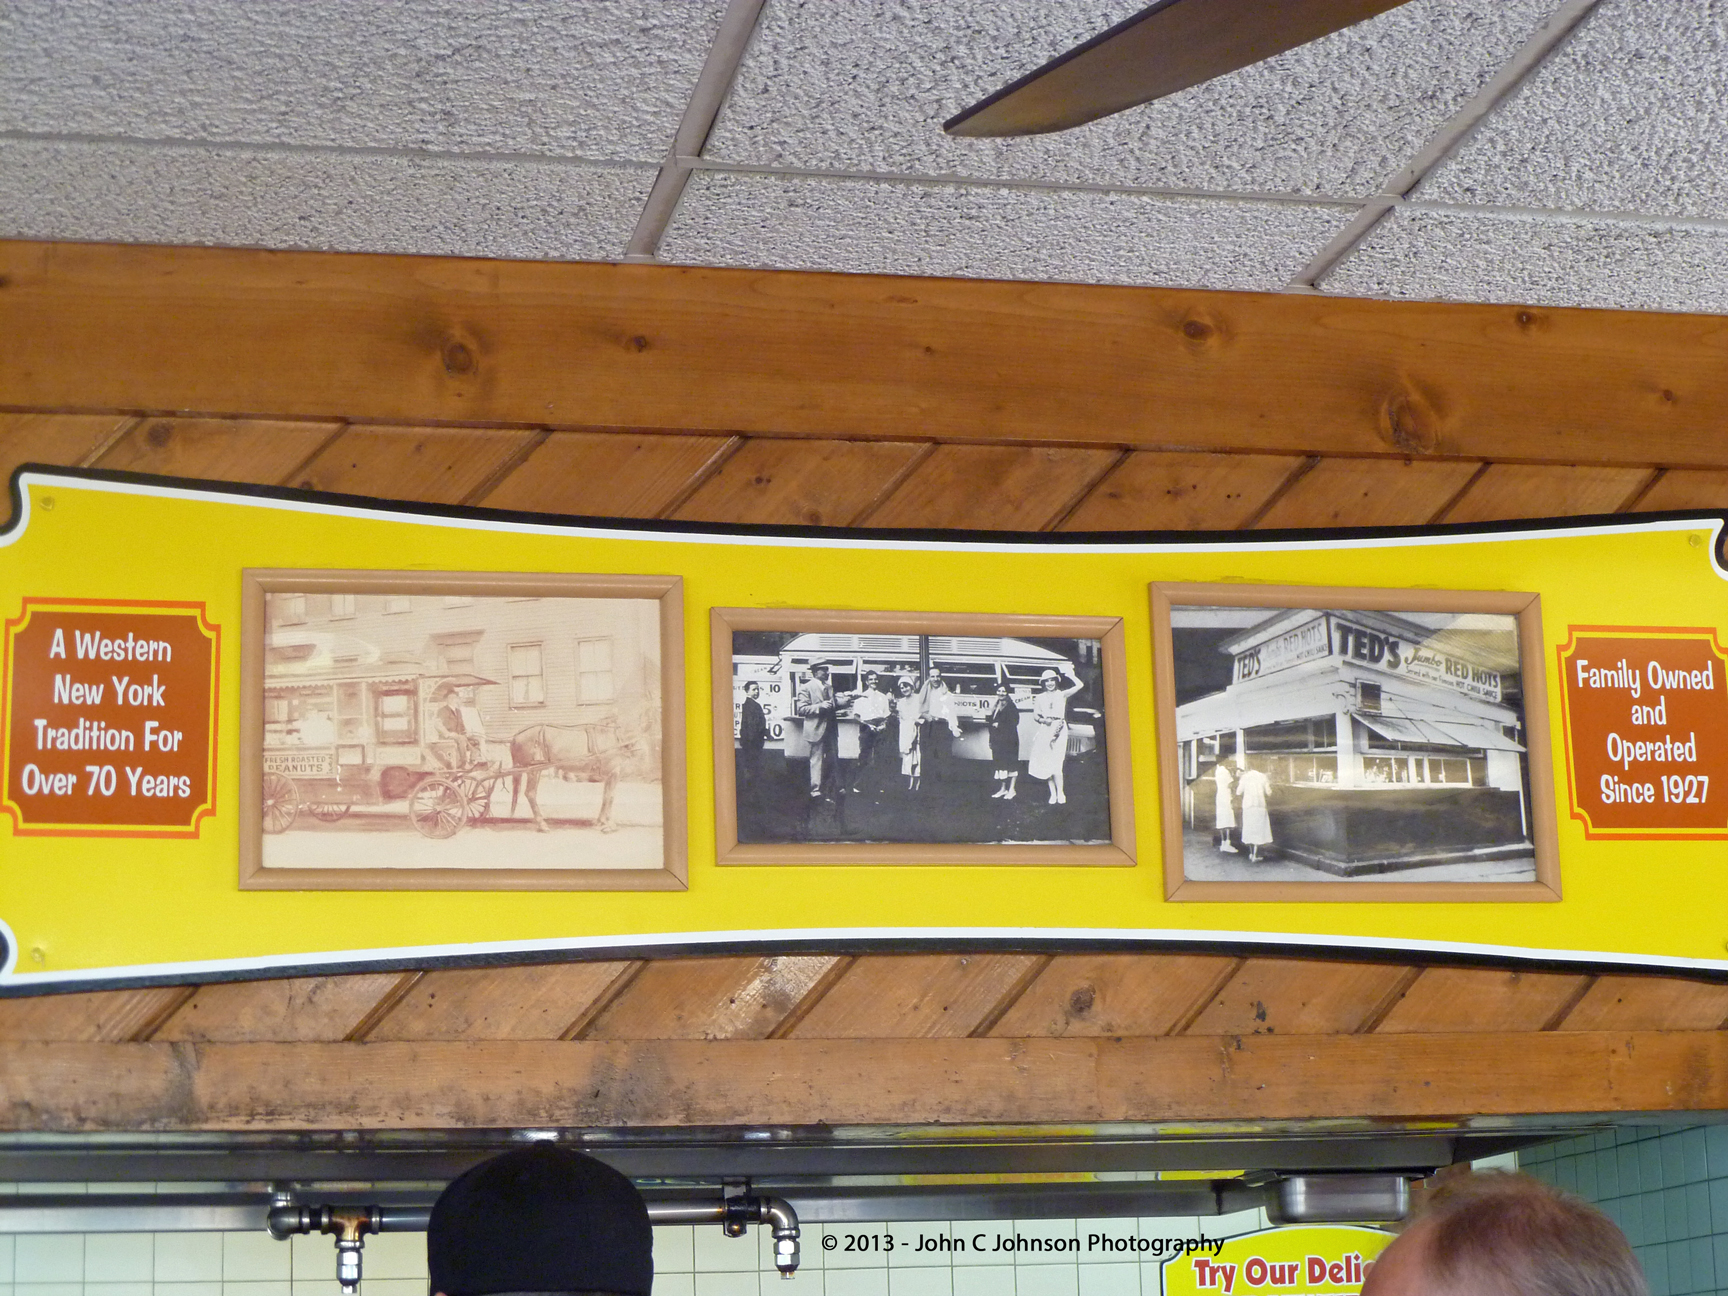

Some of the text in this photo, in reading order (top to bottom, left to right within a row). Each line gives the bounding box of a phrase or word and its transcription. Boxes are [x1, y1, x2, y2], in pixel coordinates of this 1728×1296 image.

[50, 628, 172, 662] A Western
[1301, 622, 1323, 647] HOTS
[1334, 621, 1499, 689] TED'S Jumbo RED HOTS
[54, 673, 166, 707] New York
[769, 684, 781, 693] 10
[1576, 658, 1715, 699] Family Owned
[979, 699, 990, 709] 10
[1631, 695, 1667, 725] and
[34, 717, 183, 752] Tradition For
[1607, 731, 1697, 771] Operated
[264, 756, 289, 764] FRESH
[291, 755, 326, 764] ROASTED
[268, 763, 323, 773] PEANUTS
[22, 763, 191, 798] Over 70 Years
[1600, 774, 1709, 804] Since 1927
[1193, 1258, 1237, 1294] Try
[1245, 1256, 1300, 1286] Our
